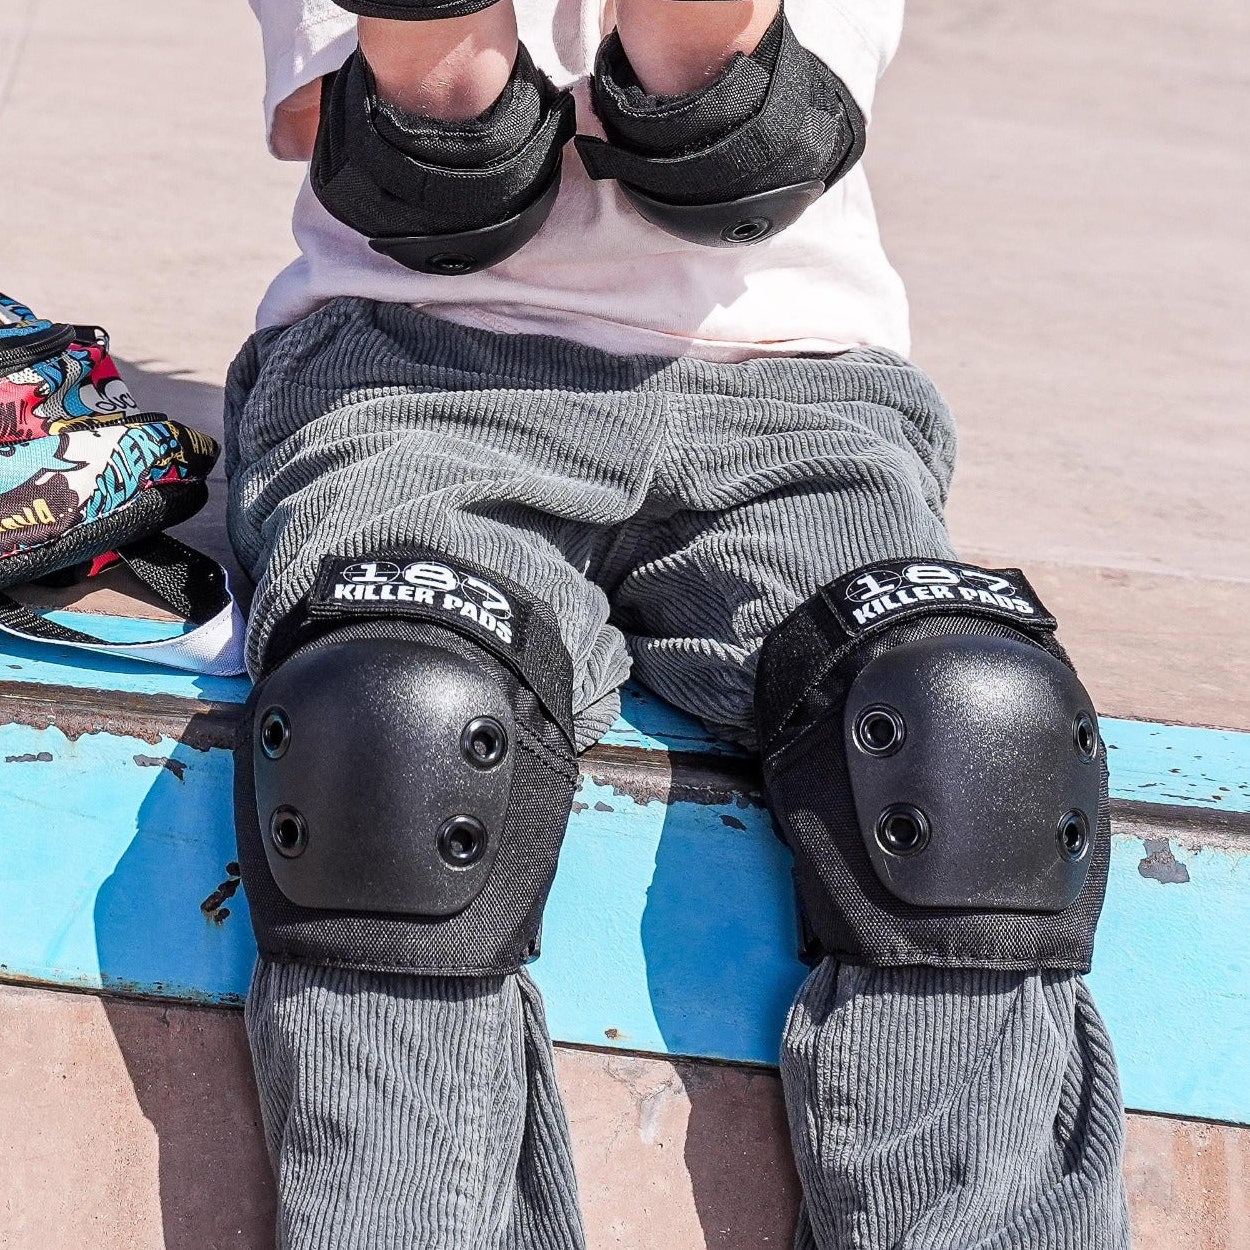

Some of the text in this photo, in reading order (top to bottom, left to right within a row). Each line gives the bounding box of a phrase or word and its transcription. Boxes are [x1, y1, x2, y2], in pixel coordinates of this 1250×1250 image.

[345, 561, 512, 617] 187
[848, 563, 1014, 601] 187
[852, 584, 1035, 625] KILLER PADS
[334, 583, 513, 644] KILLER PADS
